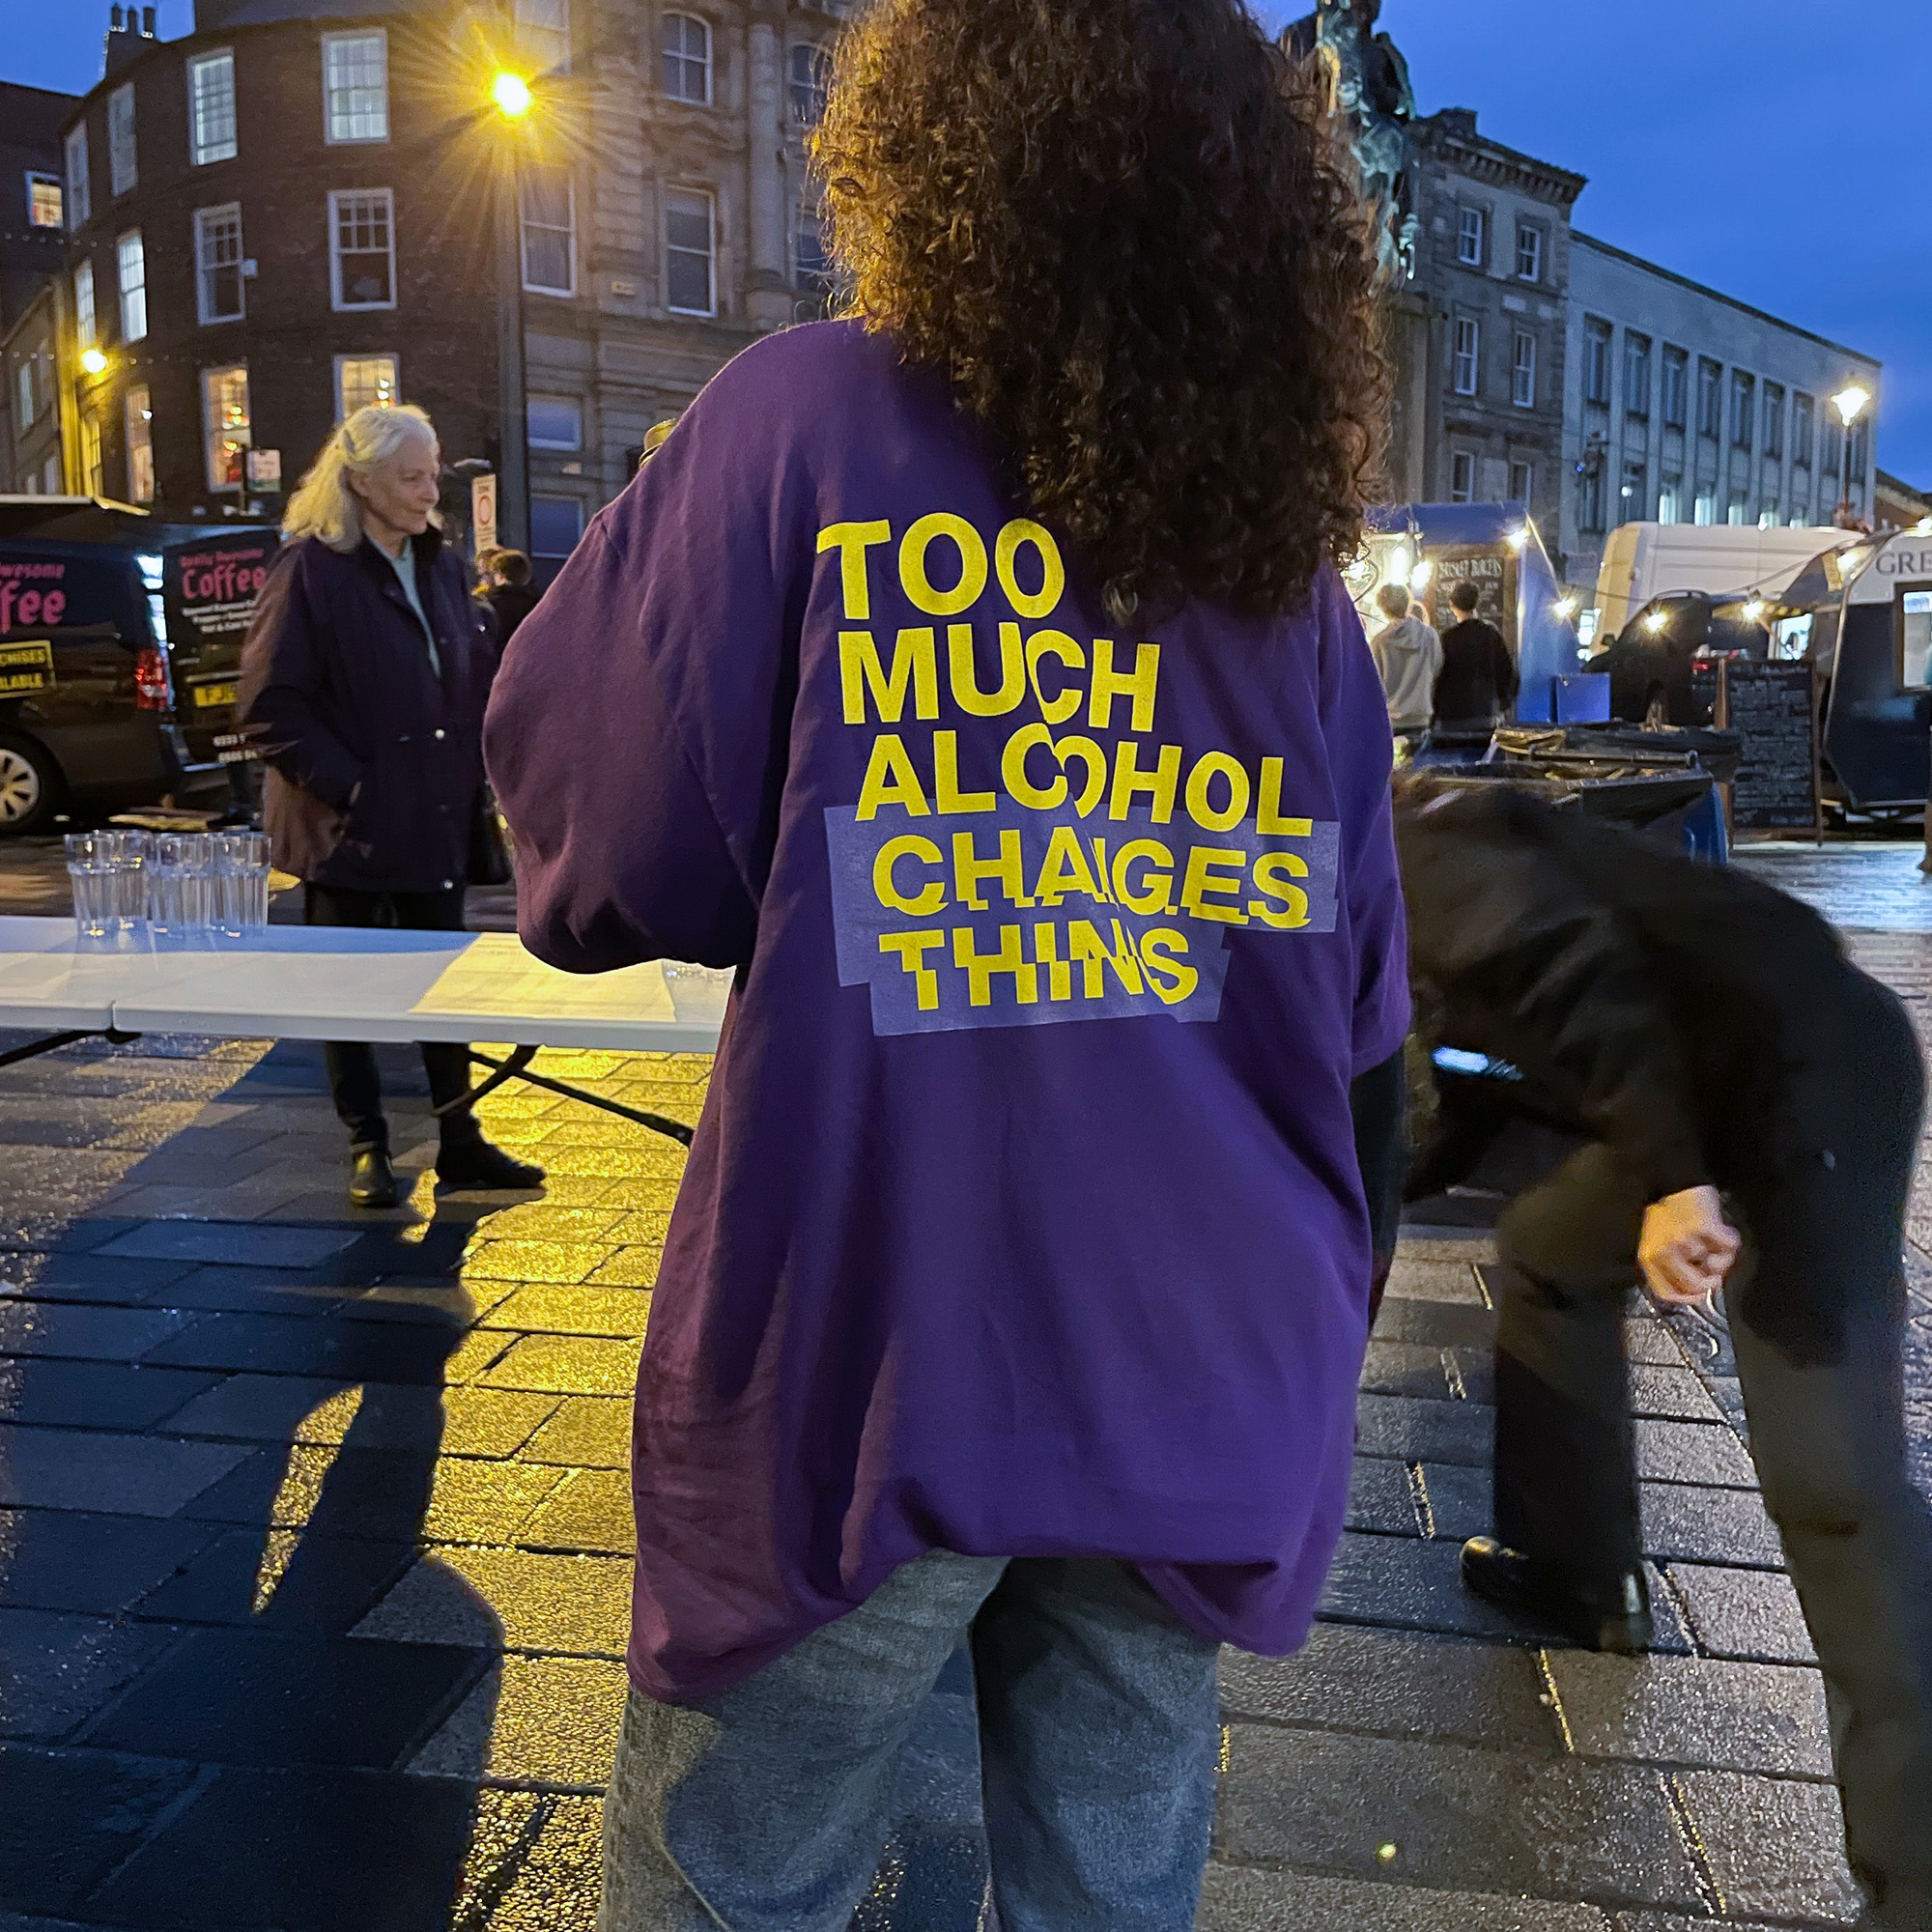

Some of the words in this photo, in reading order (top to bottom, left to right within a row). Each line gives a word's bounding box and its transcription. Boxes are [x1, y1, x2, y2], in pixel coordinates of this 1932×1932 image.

[0, 563, 66, 580] wesome
[0, 580, 67, 635] fee
[183, 562, 267, 601] Coffee
[816, 512, 1065, 620] TOO
[838, 622, 1160, 732] MUCH
[855, 723, 1313, 838] ALCOHOL
[879, 918, 1198, 1010] THINS
